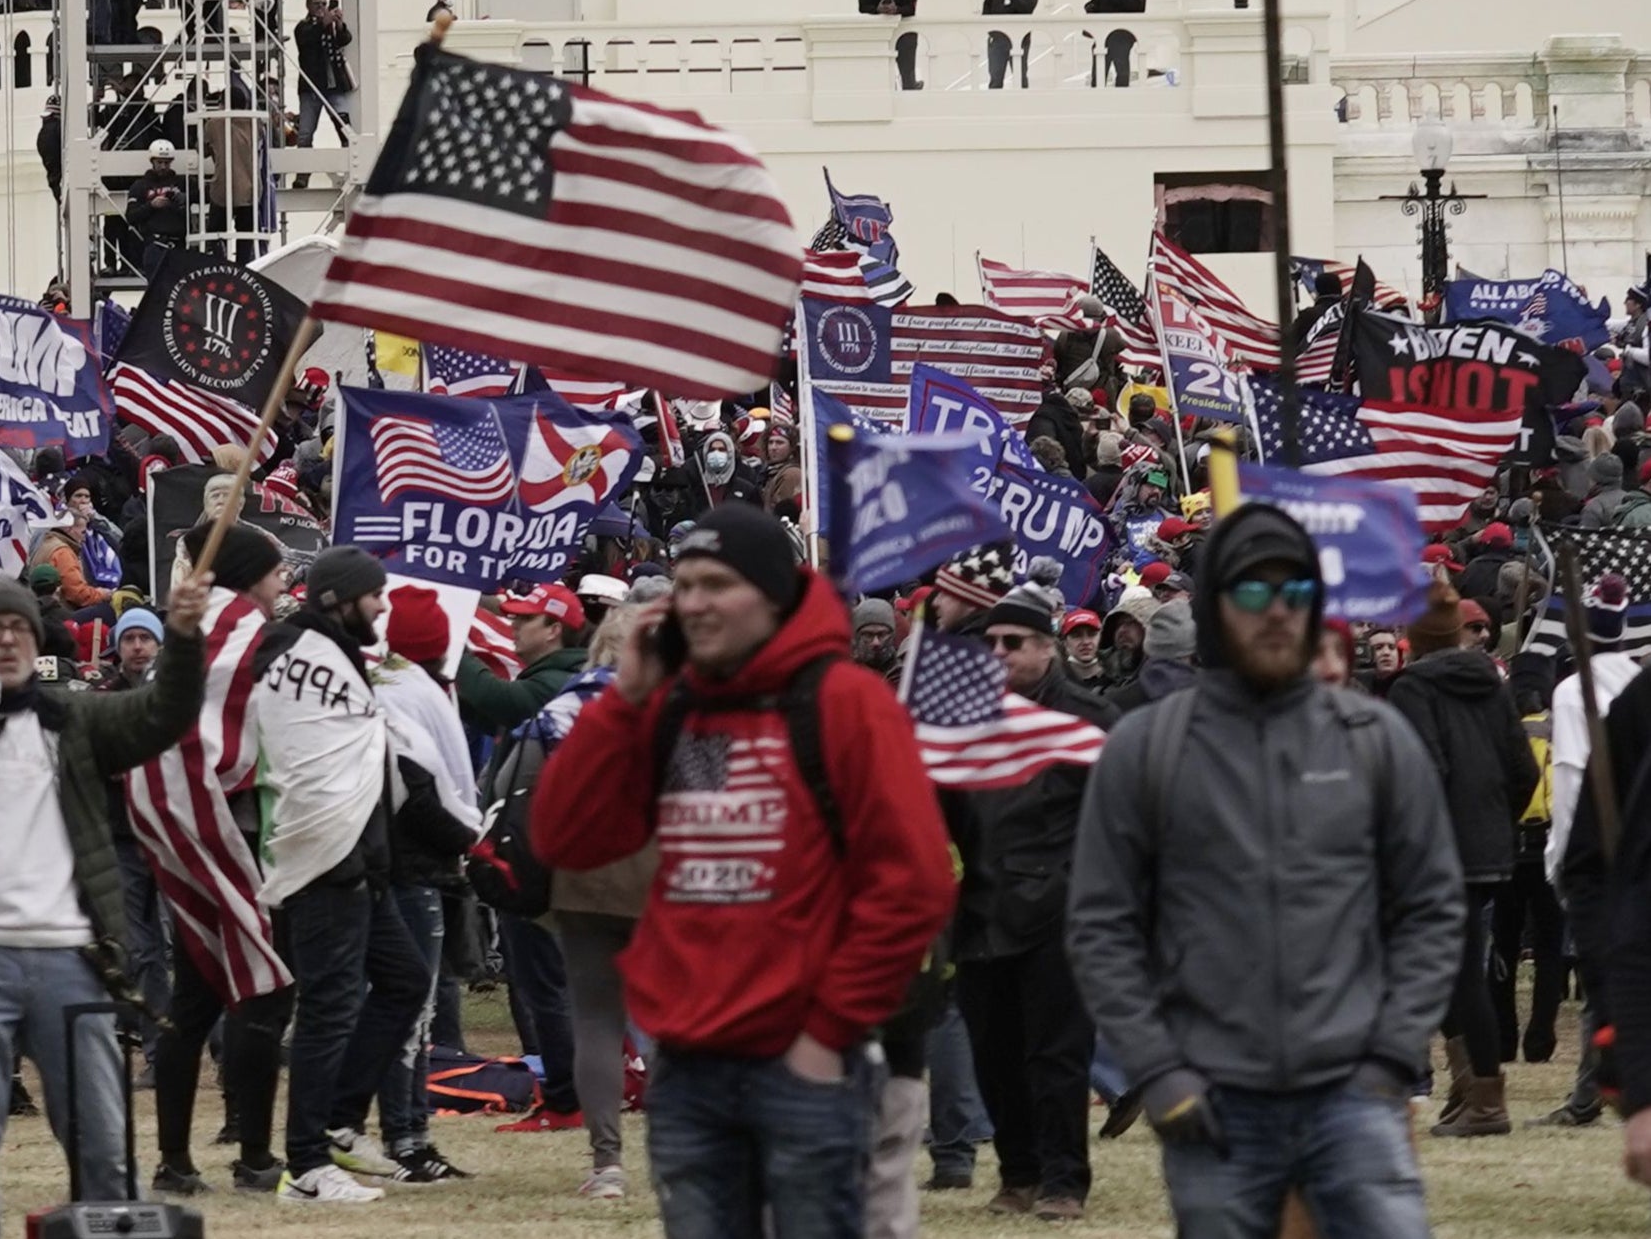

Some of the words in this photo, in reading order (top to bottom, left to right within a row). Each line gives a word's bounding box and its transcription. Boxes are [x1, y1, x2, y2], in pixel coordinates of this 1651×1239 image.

[167, 278, 188, 309] WHEN
[189, 265, 240, 281] TYRANNY
[241, 271, 273, 321] BECOMES
[1470, 284, 1502, 300] ALL
[837, 322, 861, 343] III
[1407, 323, 1518, 365] BIDEN
[163, 318, 199, 379] REBELLION
[243, 358, 265, 382] DUTY
[203, 336, 232, 359] 1776
[840, 343, 861, 354] 1776
[1180, 393, 1233, 412] President
[279, 516, 296, 526] NO
[403, 502, 579, 554] FLORIDA
[405, 544, 467, 574] FOR
